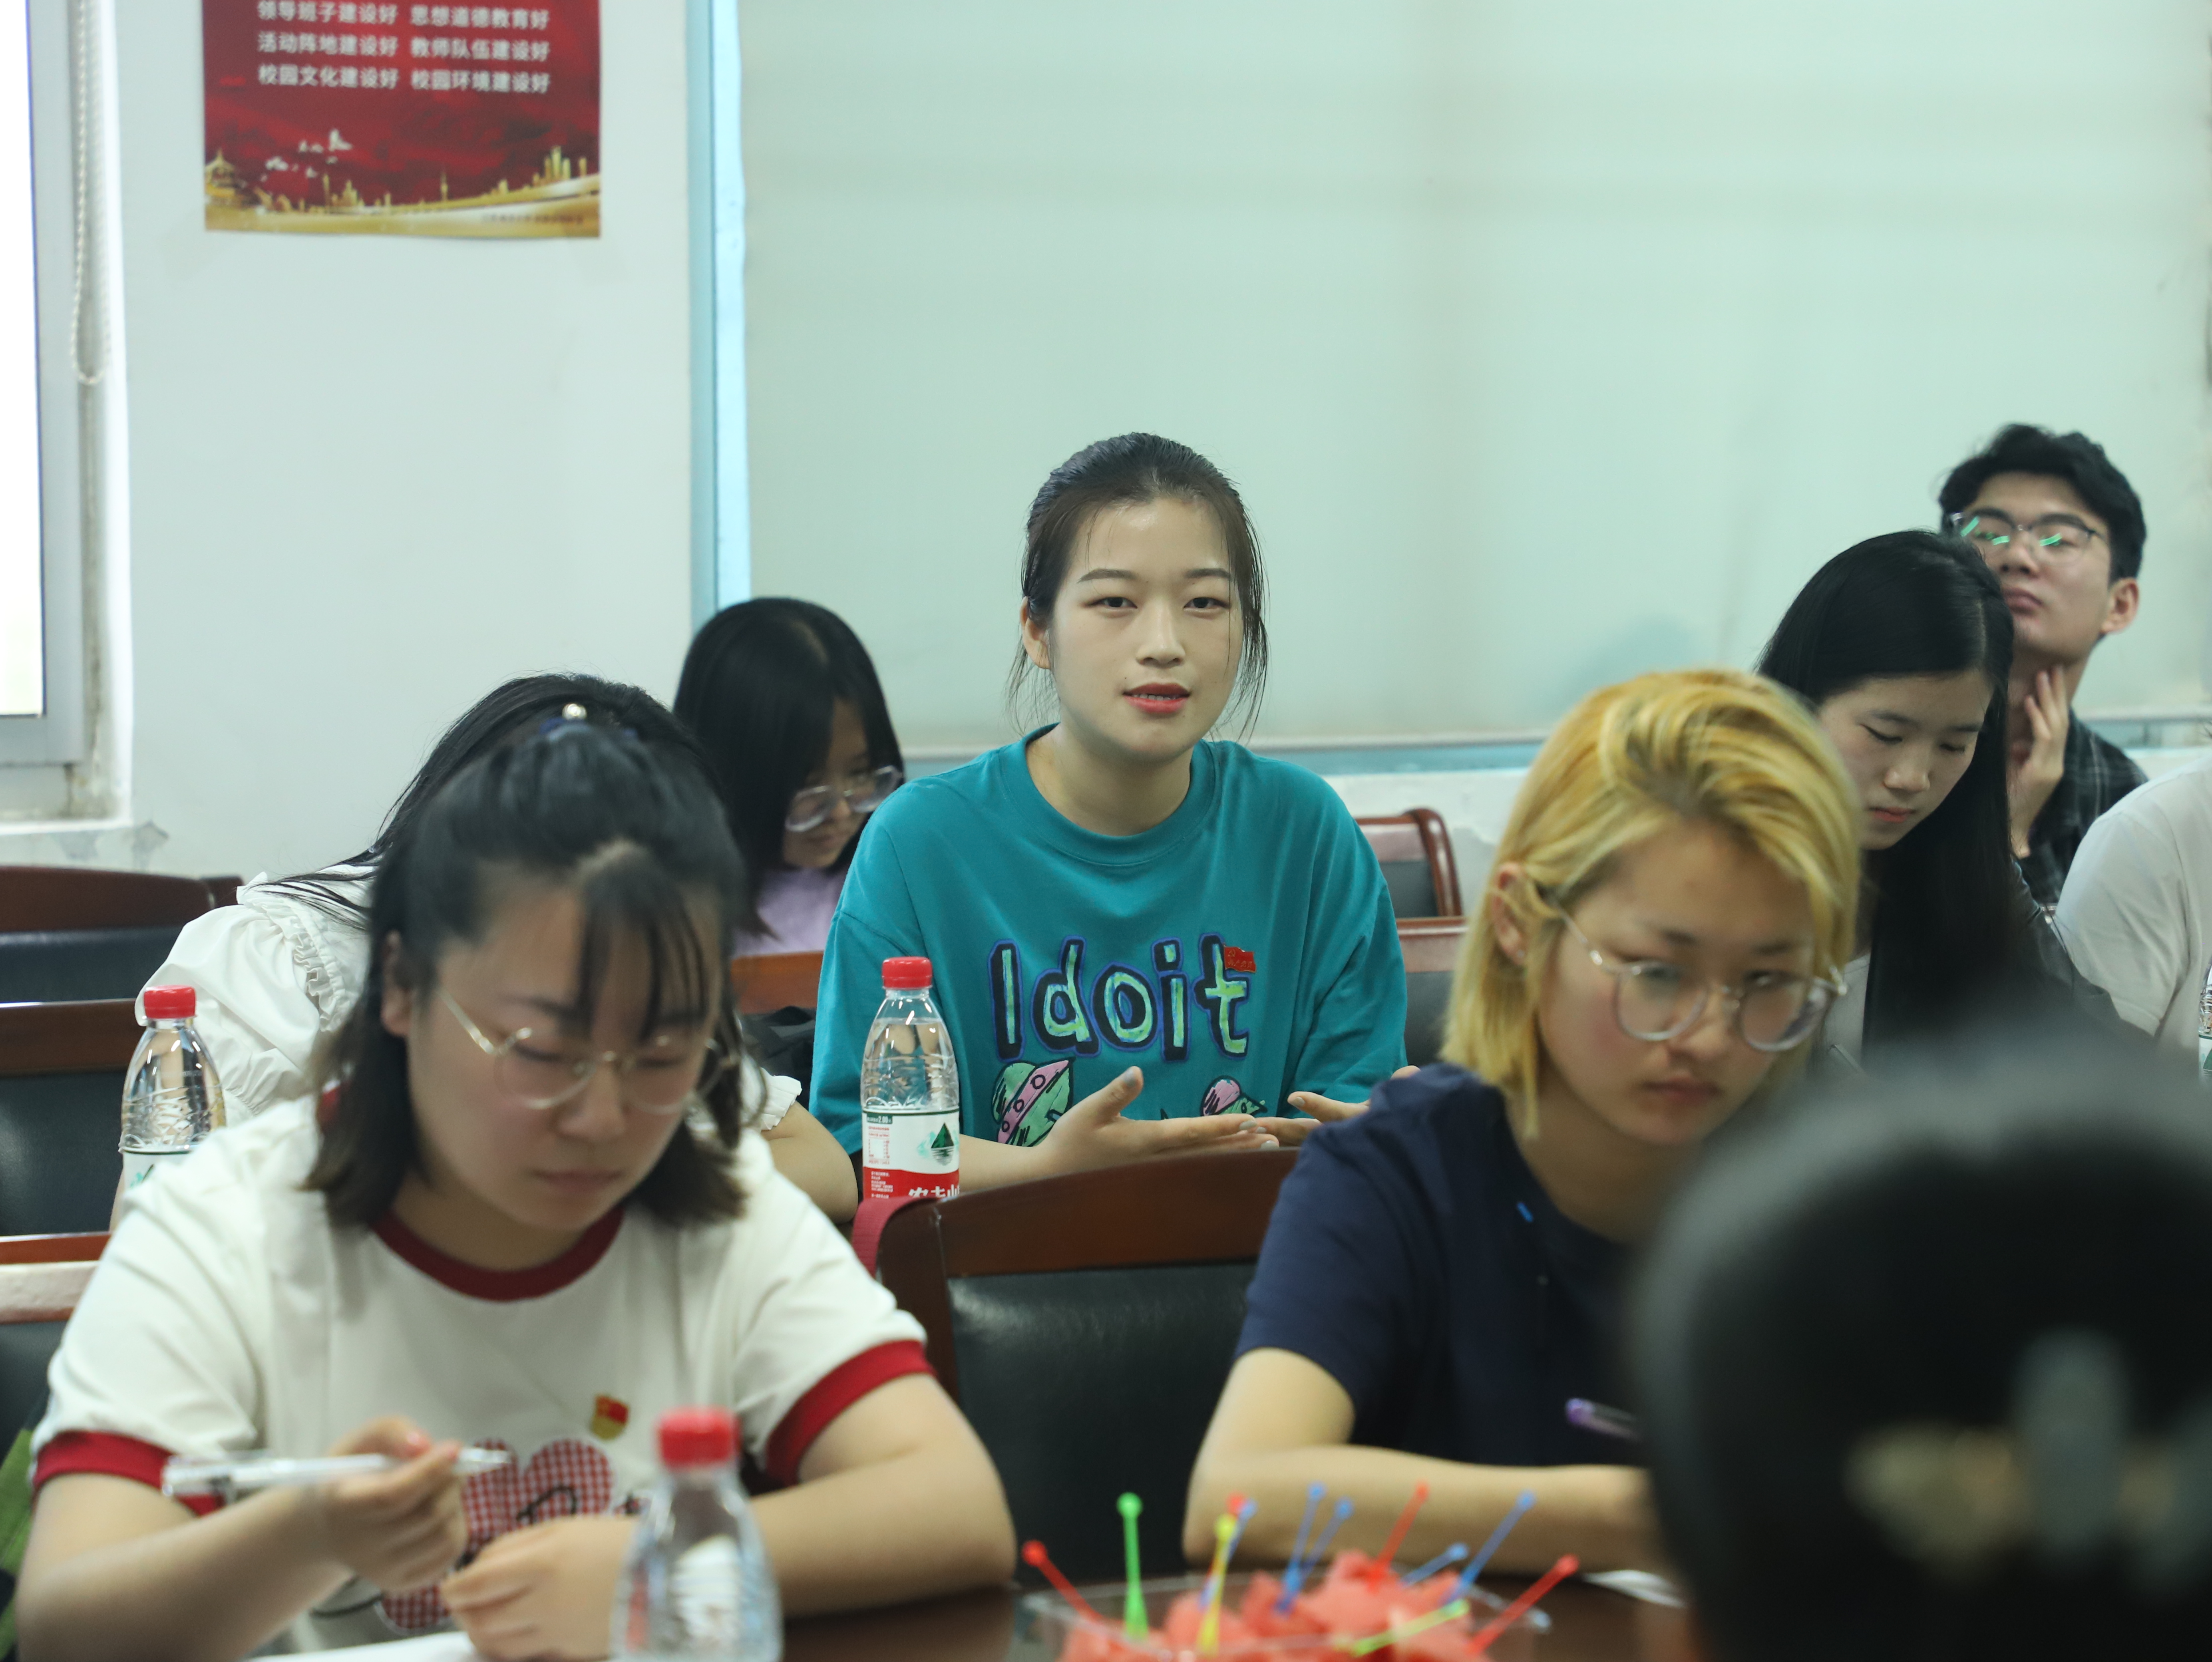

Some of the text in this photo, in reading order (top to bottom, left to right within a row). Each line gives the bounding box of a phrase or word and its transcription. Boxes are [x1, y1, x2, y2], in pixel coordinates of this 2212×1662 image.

[258, 62, 550, 94] 校园文化建设好 校园环境建设好
